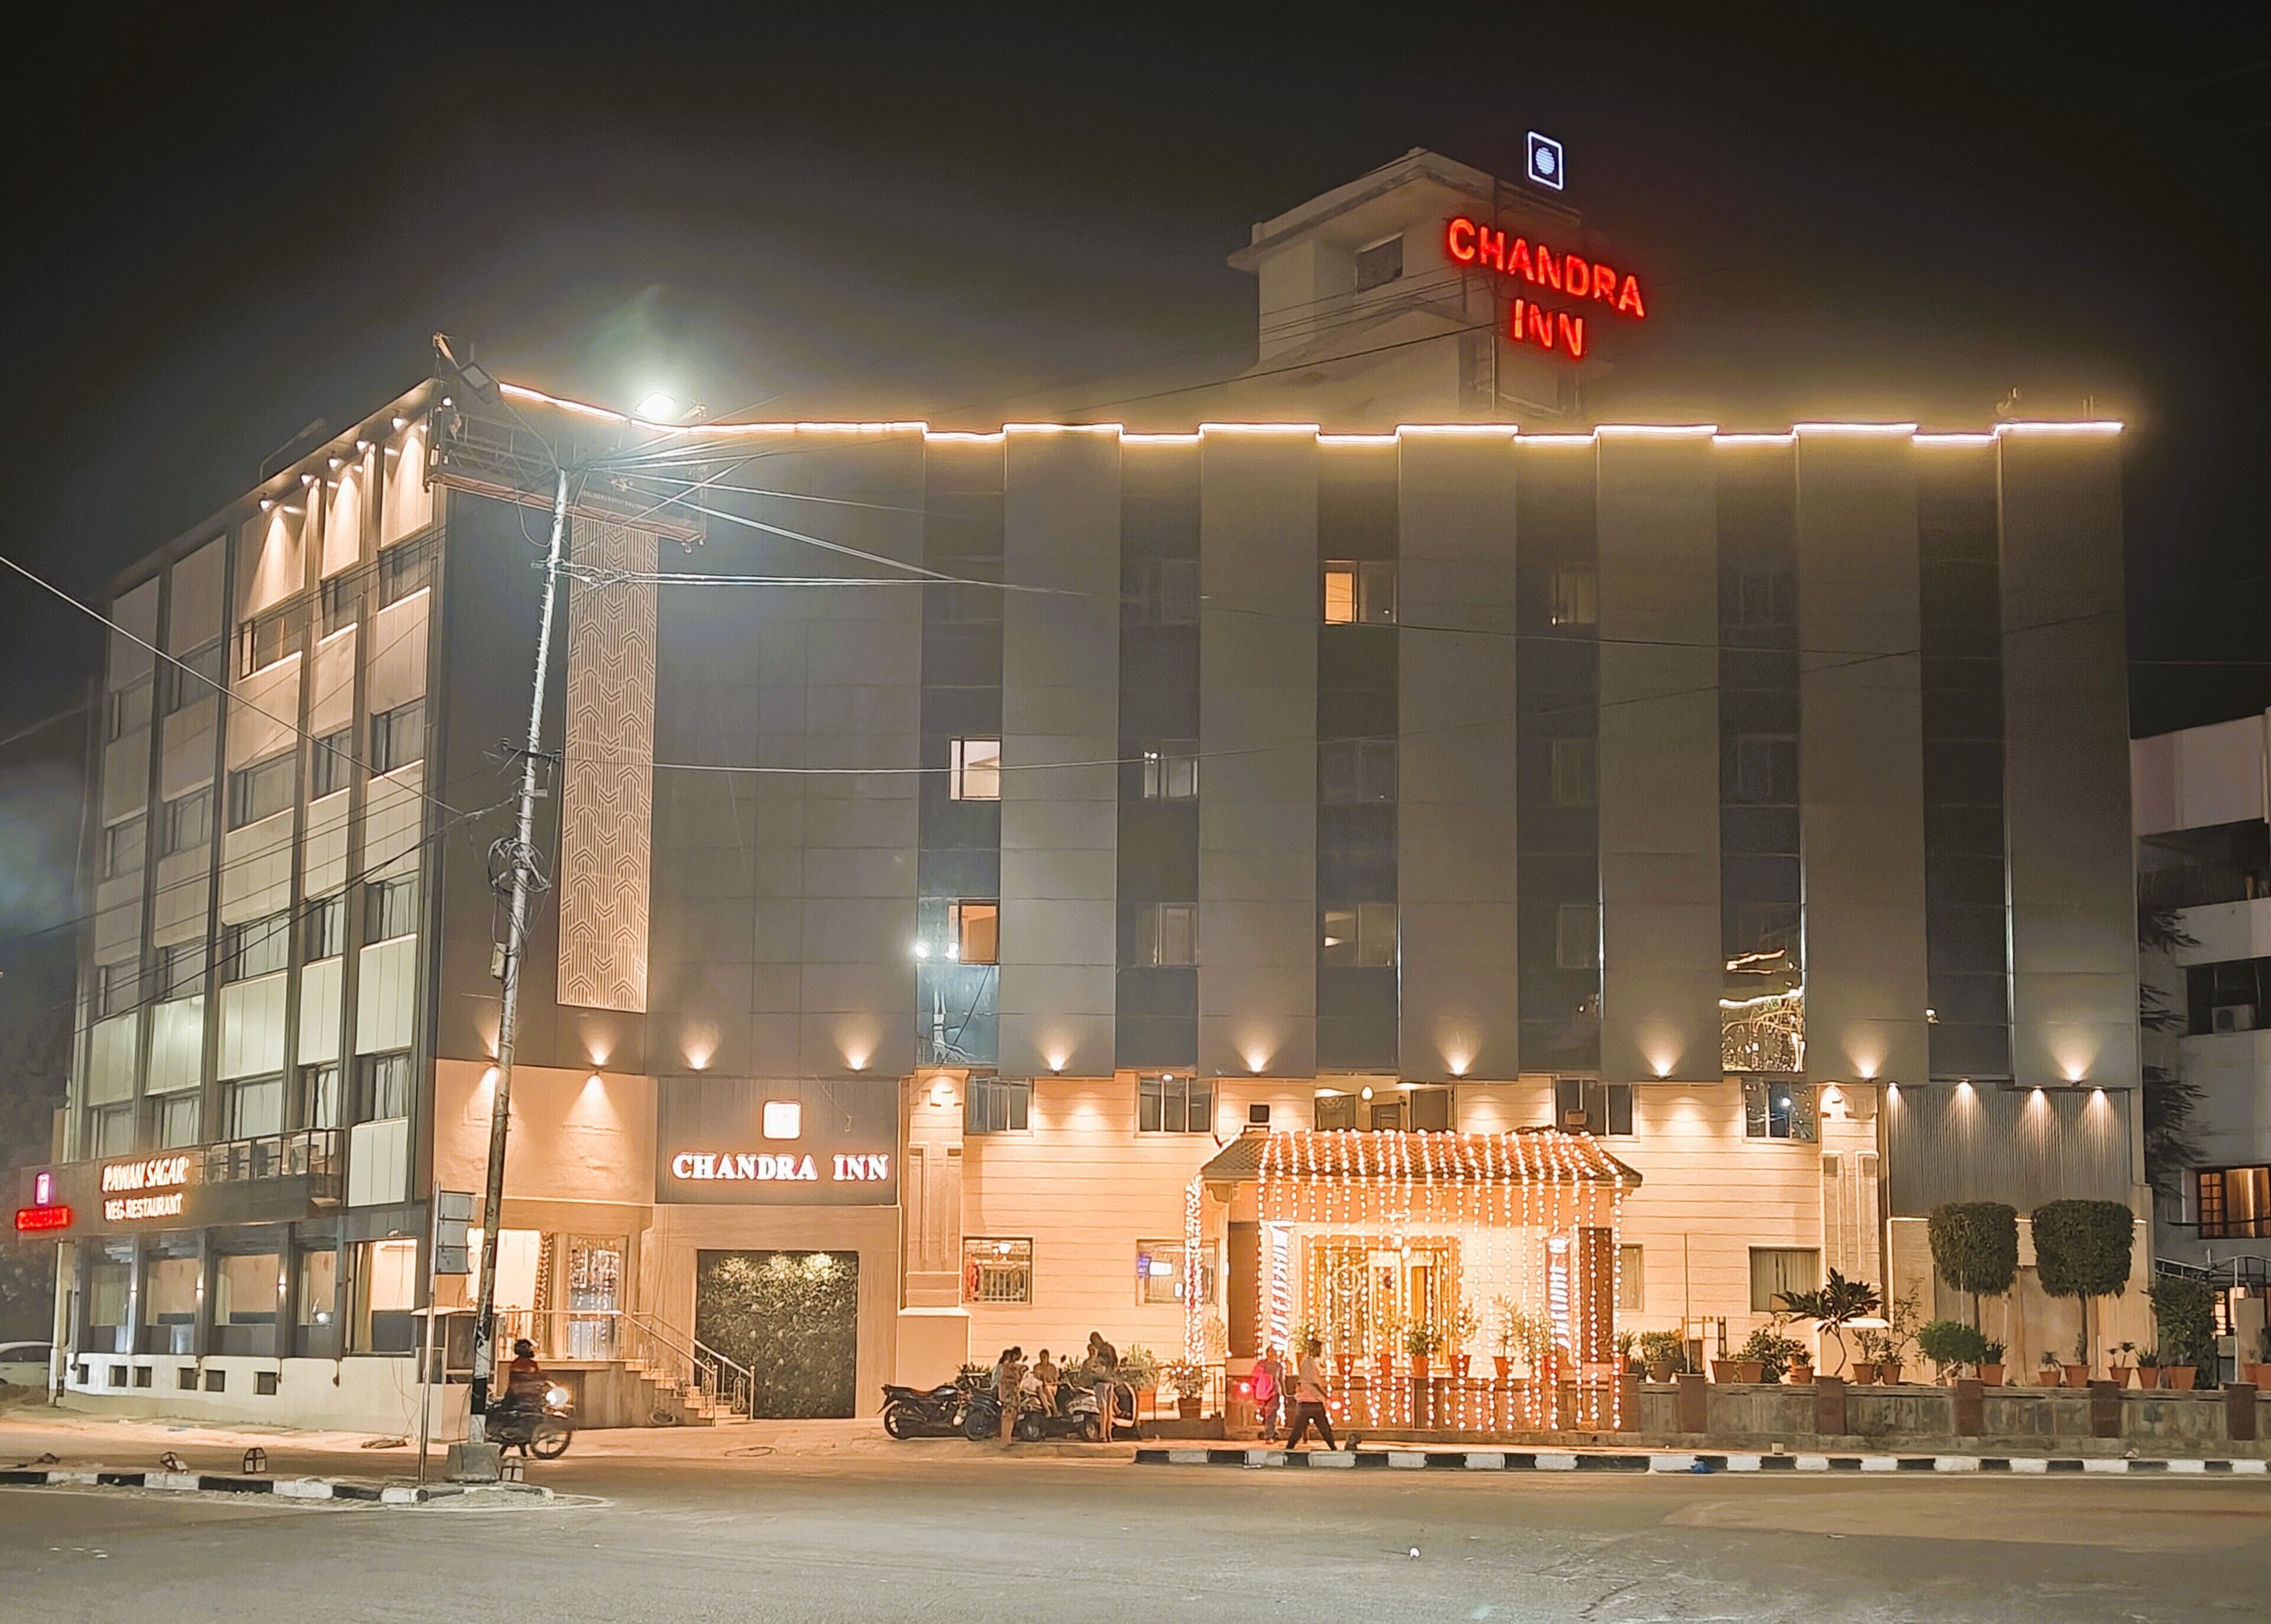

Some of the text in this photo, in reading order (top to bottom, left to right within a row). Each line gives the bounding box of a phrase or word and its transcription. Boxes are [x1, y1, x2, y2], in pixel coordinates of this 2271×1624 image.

[1448, 218, 1645, 318] CHANDRA
[1513, 298, 1583, 356] INN
[102, 1156, 187, 1192] PAWAN SAGAR
[672, 1152, 889, 1181] CHANDRA INN
[105, 1193, 183, 1220] VEG RESTAURANT
